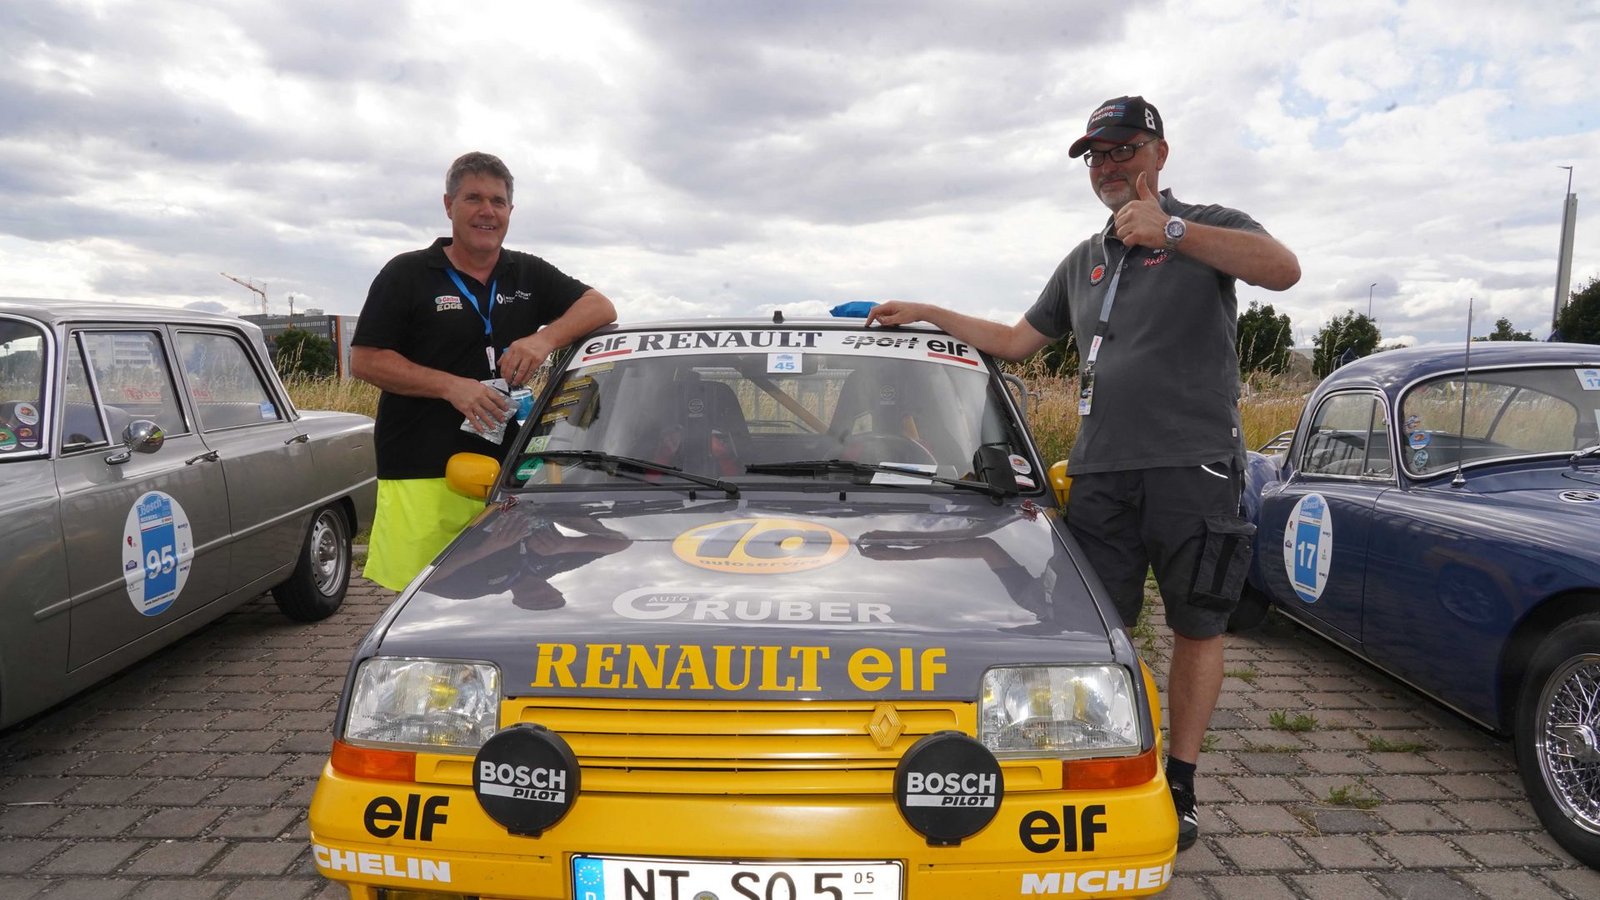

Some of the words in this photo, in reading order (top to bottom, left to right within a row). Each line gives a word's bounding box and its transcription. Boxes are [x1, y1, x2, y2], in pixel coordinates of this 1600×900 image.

[436, 302, 463, 312] EDGE
[584, 335, 627, 355] elf
[634, 331, 822, 352] RENAULT
[841, 335, 919, 350] sport
[926, 340, 969, 357] elf
[774, 361, 796, 371] 45
[146, 545, 176, 580] 95
[698, 558, 824, 568] autoservice
[1297, 541, 1317, 570] 17
[648, 595, 690, 603] AUTO
[530, 643, 830, 692] RENAULT
[847, 647, 947, 692] elf
[480, 760, 567, 791] BOSCH
[907, 772, 996, 794] BOSCH
[513, 788, 559, 801] PILOT
[941, 796, 988, 806] PILOT
[363, 794, 449, 841] elf
[1019, 805, 1107, 854] elf
[623, 868, 690, 900] NT
[814, 872, 843, 900] 5
[854, 871, 874, 883] 05
